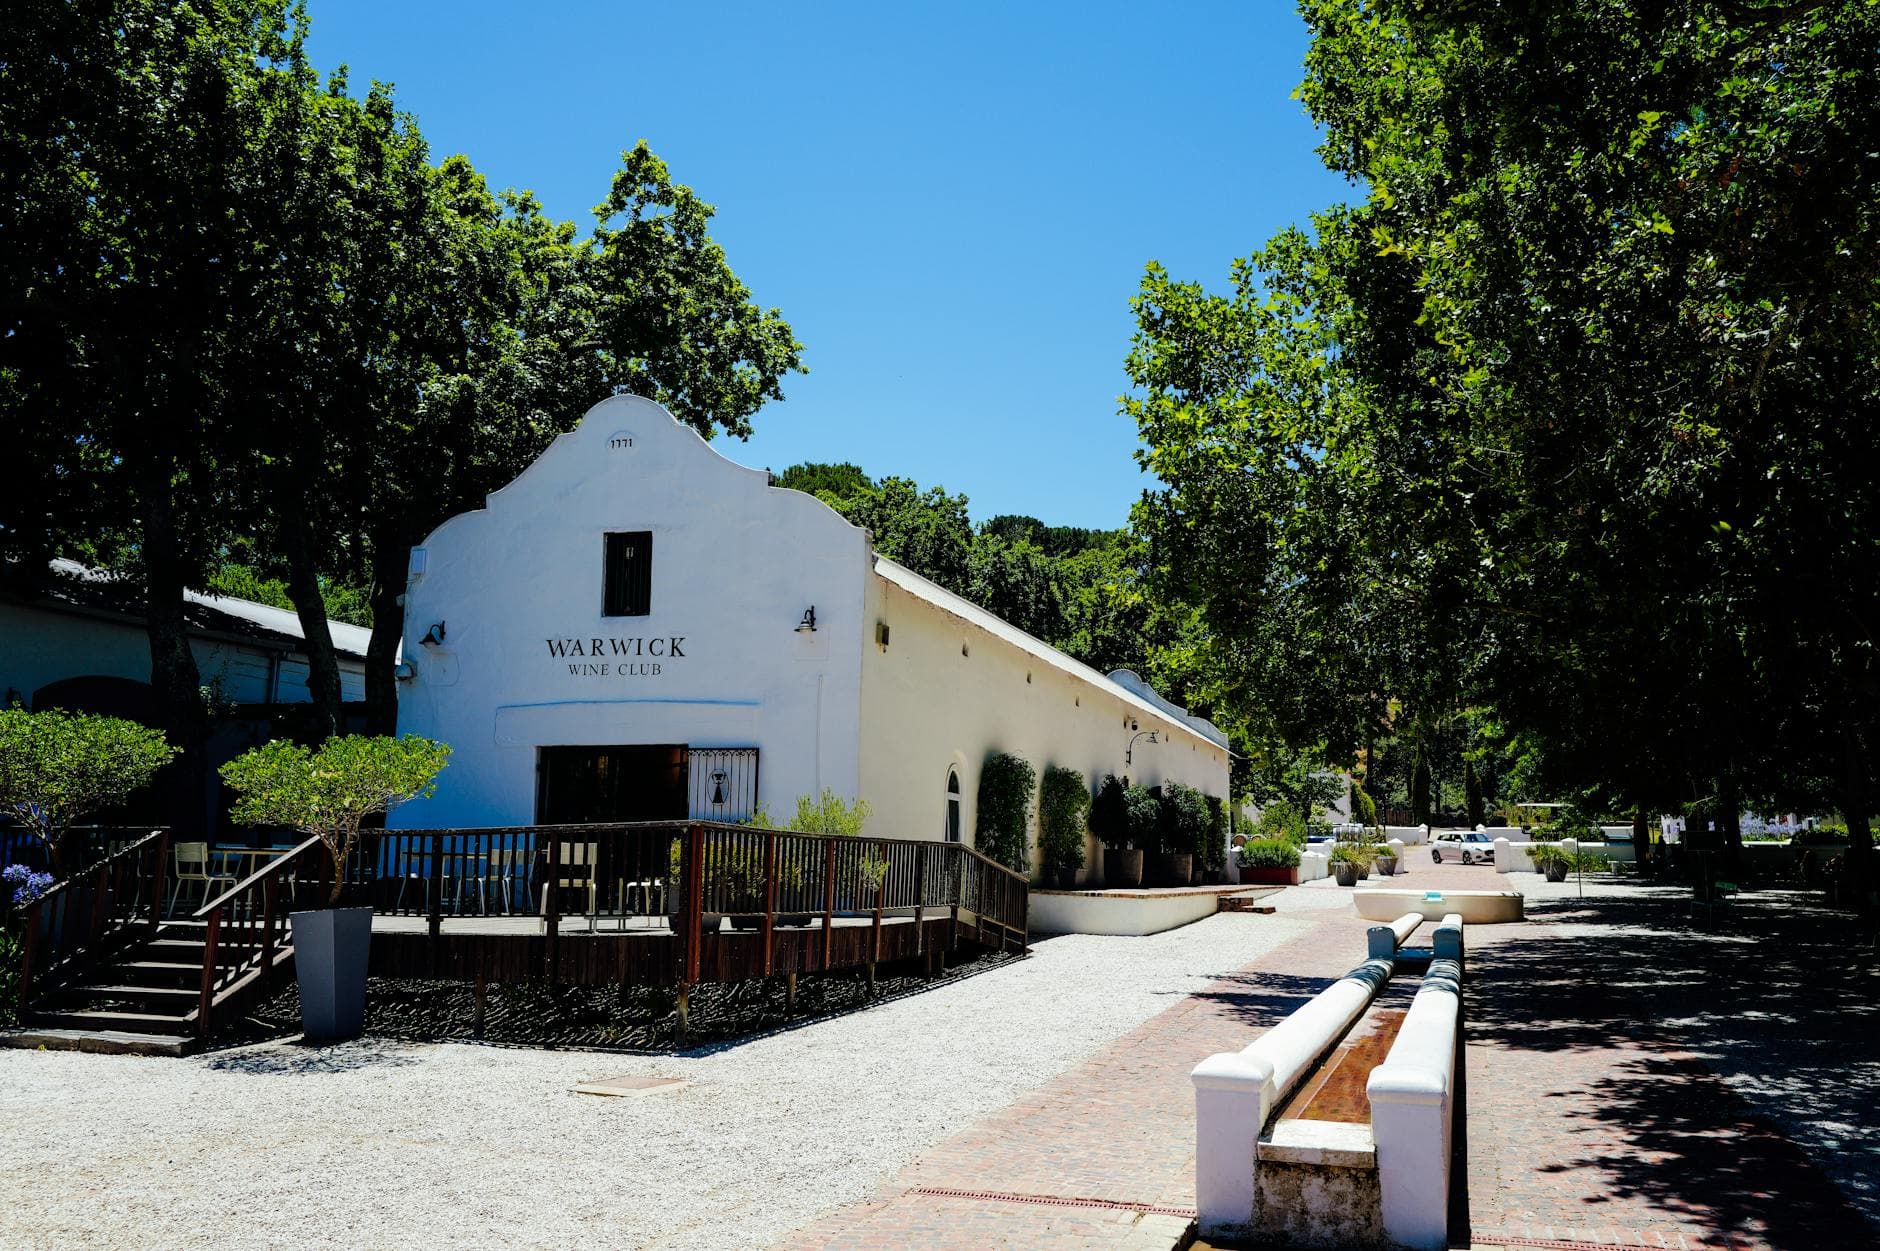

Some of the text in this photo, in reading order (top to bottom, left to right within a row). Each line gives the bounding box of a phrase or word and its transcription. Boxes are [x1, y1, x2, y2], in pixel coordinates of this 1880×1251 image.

[611, 438, 632, 448] 1771
[546, 637, 686, 658] WARWICK
[568, 663, 661, 676] WINE CLUB
